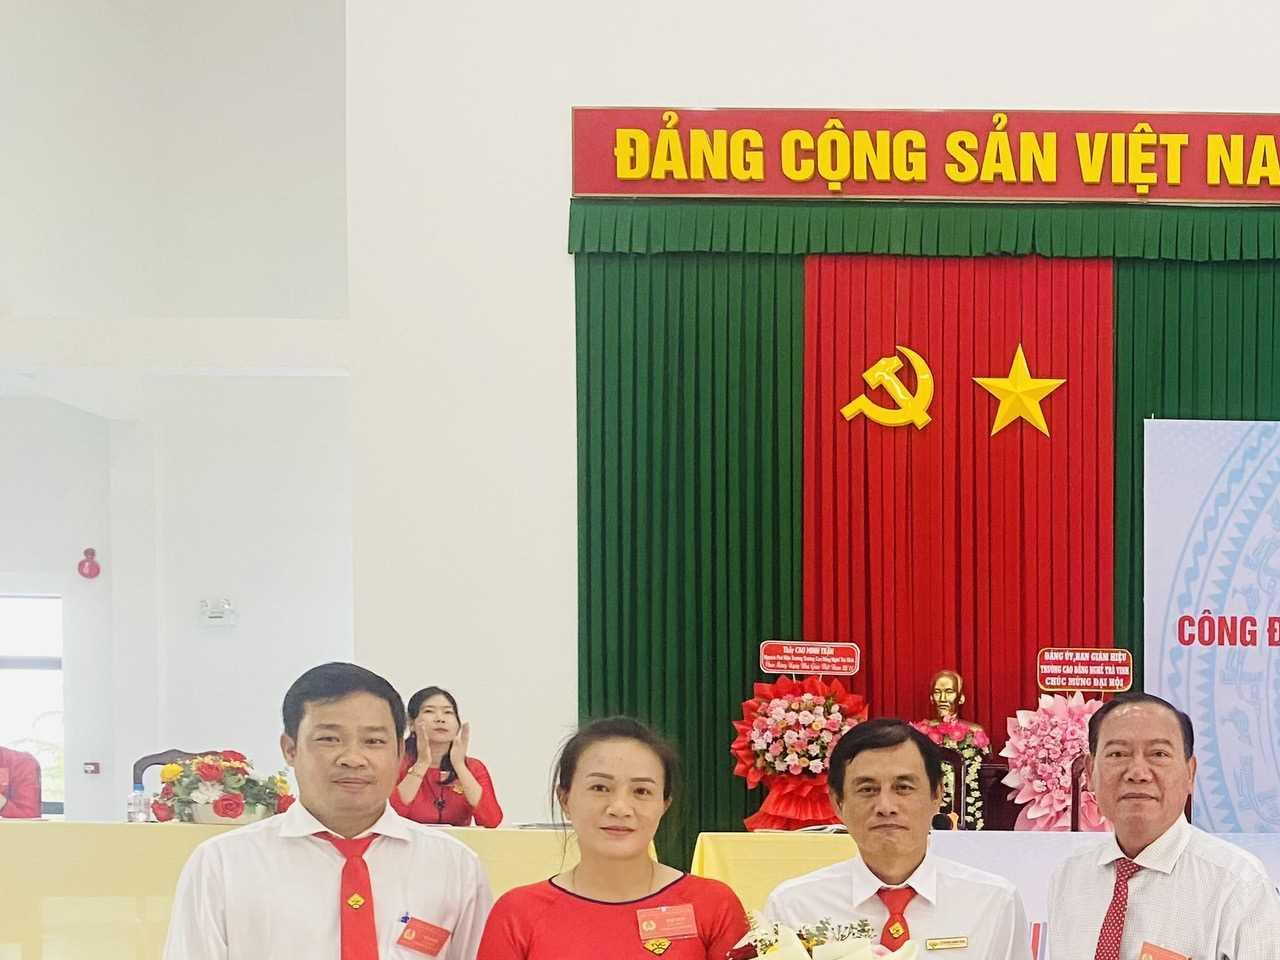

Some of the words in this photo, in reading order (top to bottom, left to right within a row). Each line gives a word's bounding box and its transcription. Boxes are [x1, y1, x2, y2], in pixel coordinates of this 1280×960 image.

[615, 111, 765, 181] ĐẢNG
[781, 118, 927, 192] CỘNG
[944, 113, 1057, 183] SẢN
[1075, 122, 1189, 195] VIỆT
[1177, 608, 1258, 648] CÔNG
[1045, 676, 1066, 686] CHÚC
[1062, 665, 1074, 674] CAO
